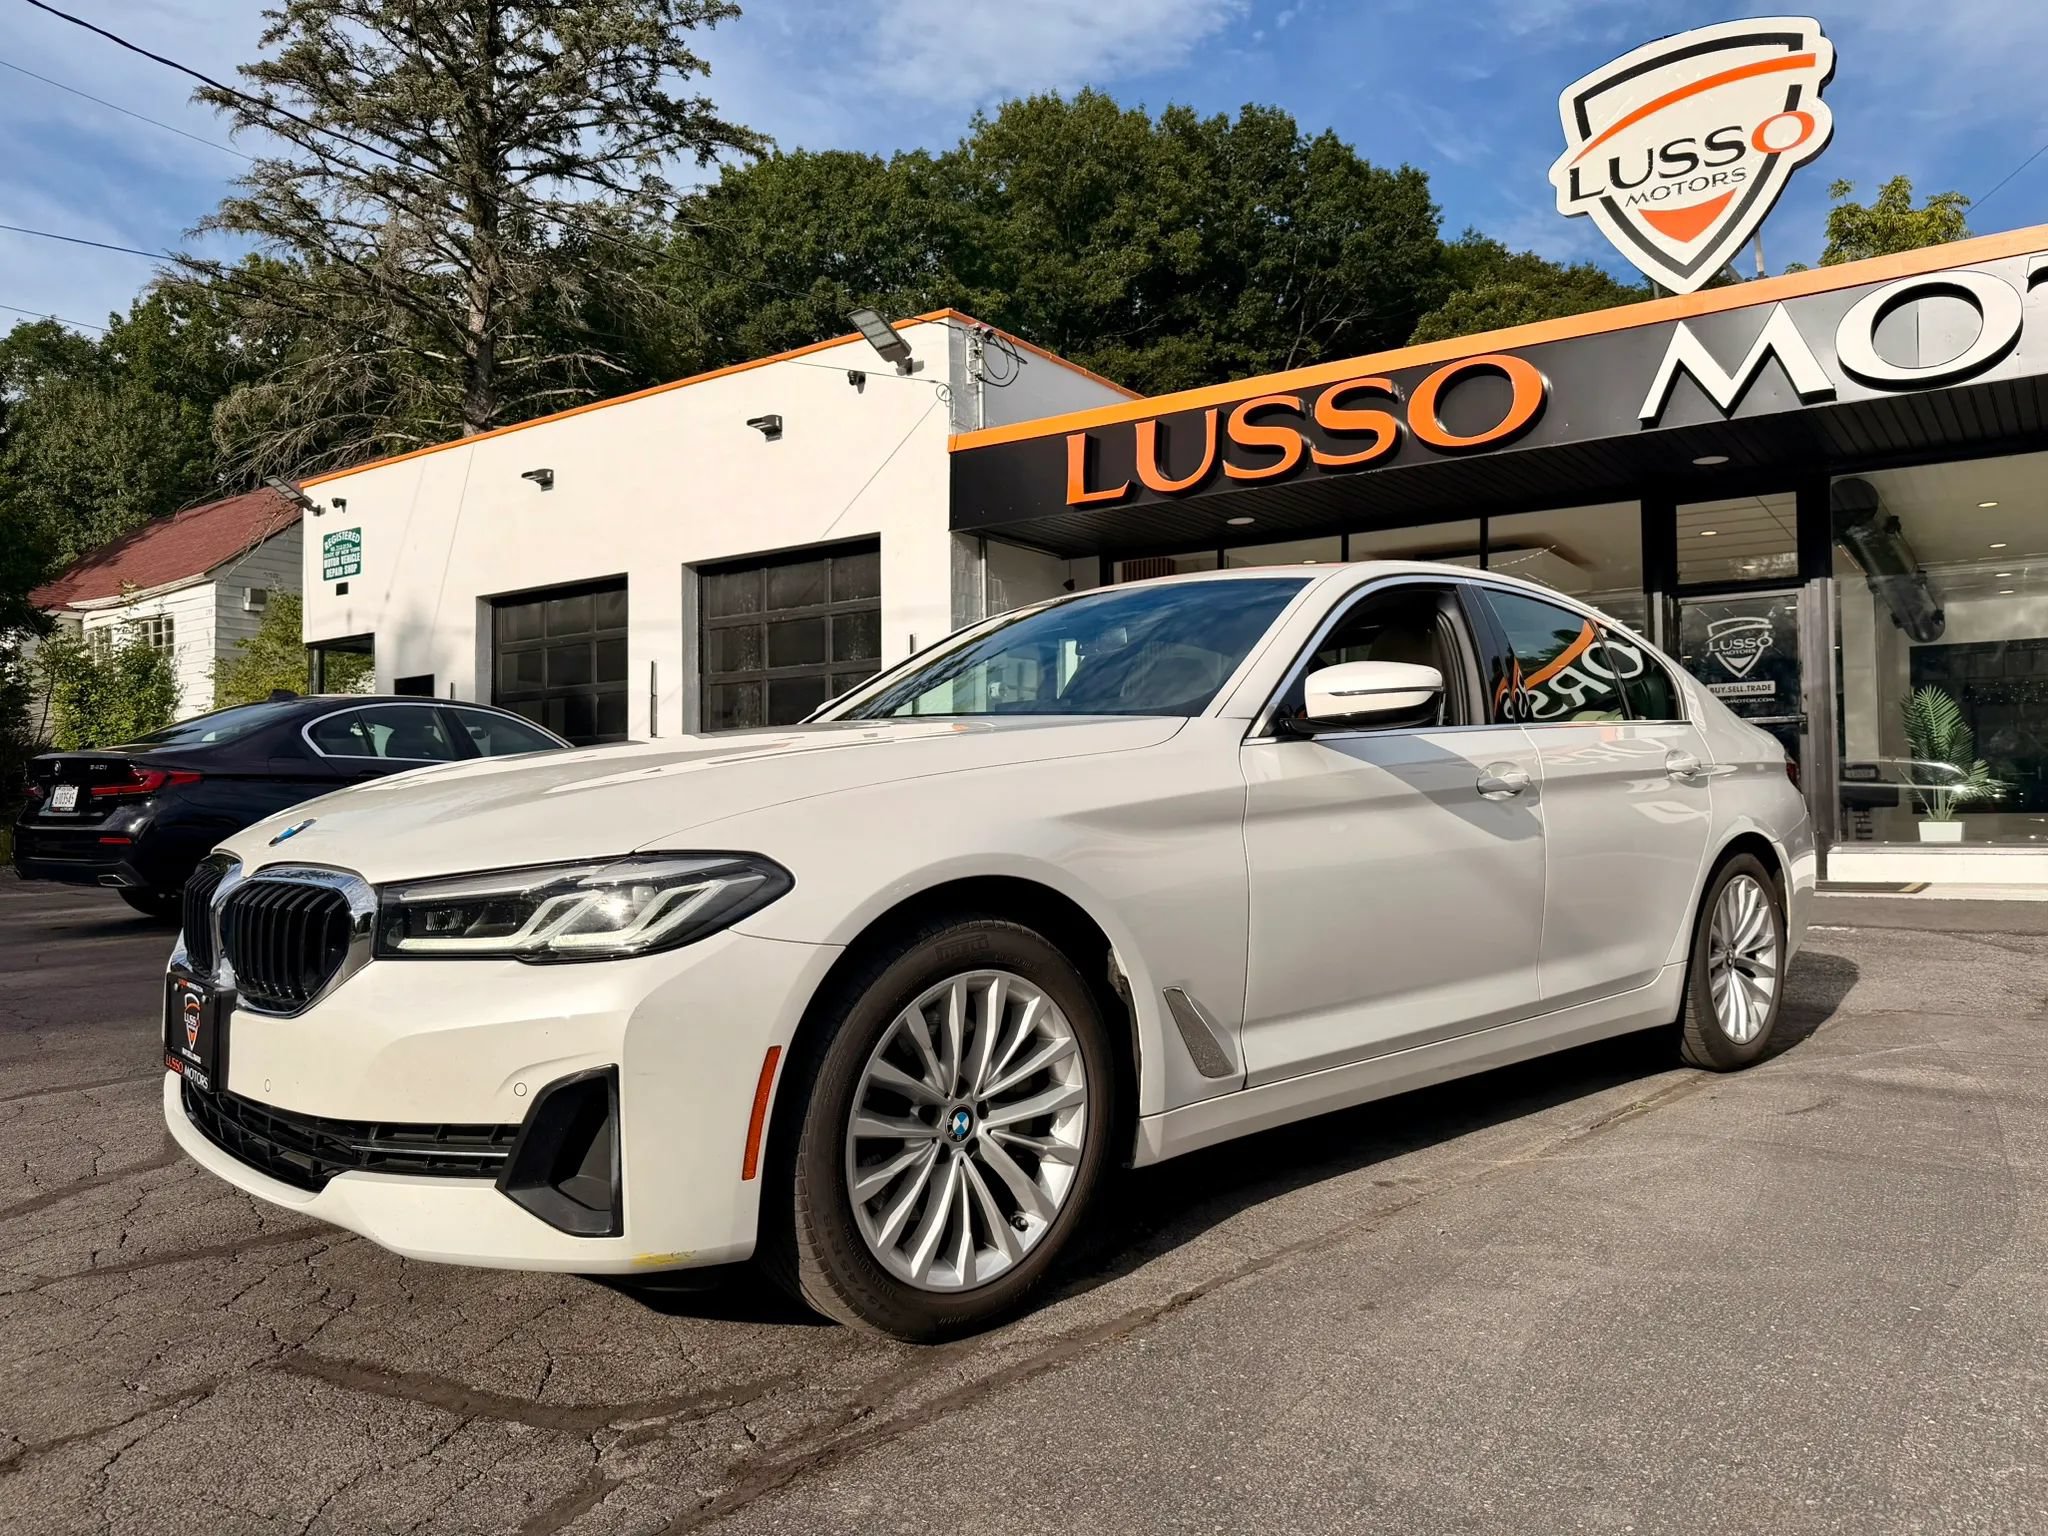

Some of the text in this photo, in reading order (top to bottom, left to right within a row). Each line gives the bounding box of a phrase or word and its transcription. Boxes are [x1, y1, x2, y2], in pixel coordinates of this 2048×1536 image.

[1569, 110, 1816, 203] LUSSO
[1625, 166, 1747, 208] MOTORS
[1065, 254, 2048, 507] LUSSO MO
[324, 531, 360, 551] REGISTERED
[324, 552, 360, 568] MOTOR VEHICLE
[326, 563, 358, 578] REPAIR SHOP
[1709, 636, 1773, 652] LUSSO
[166, 1054, 184, 1073] LUSSO
[185, 1063, 208, 1089] MOTORS
